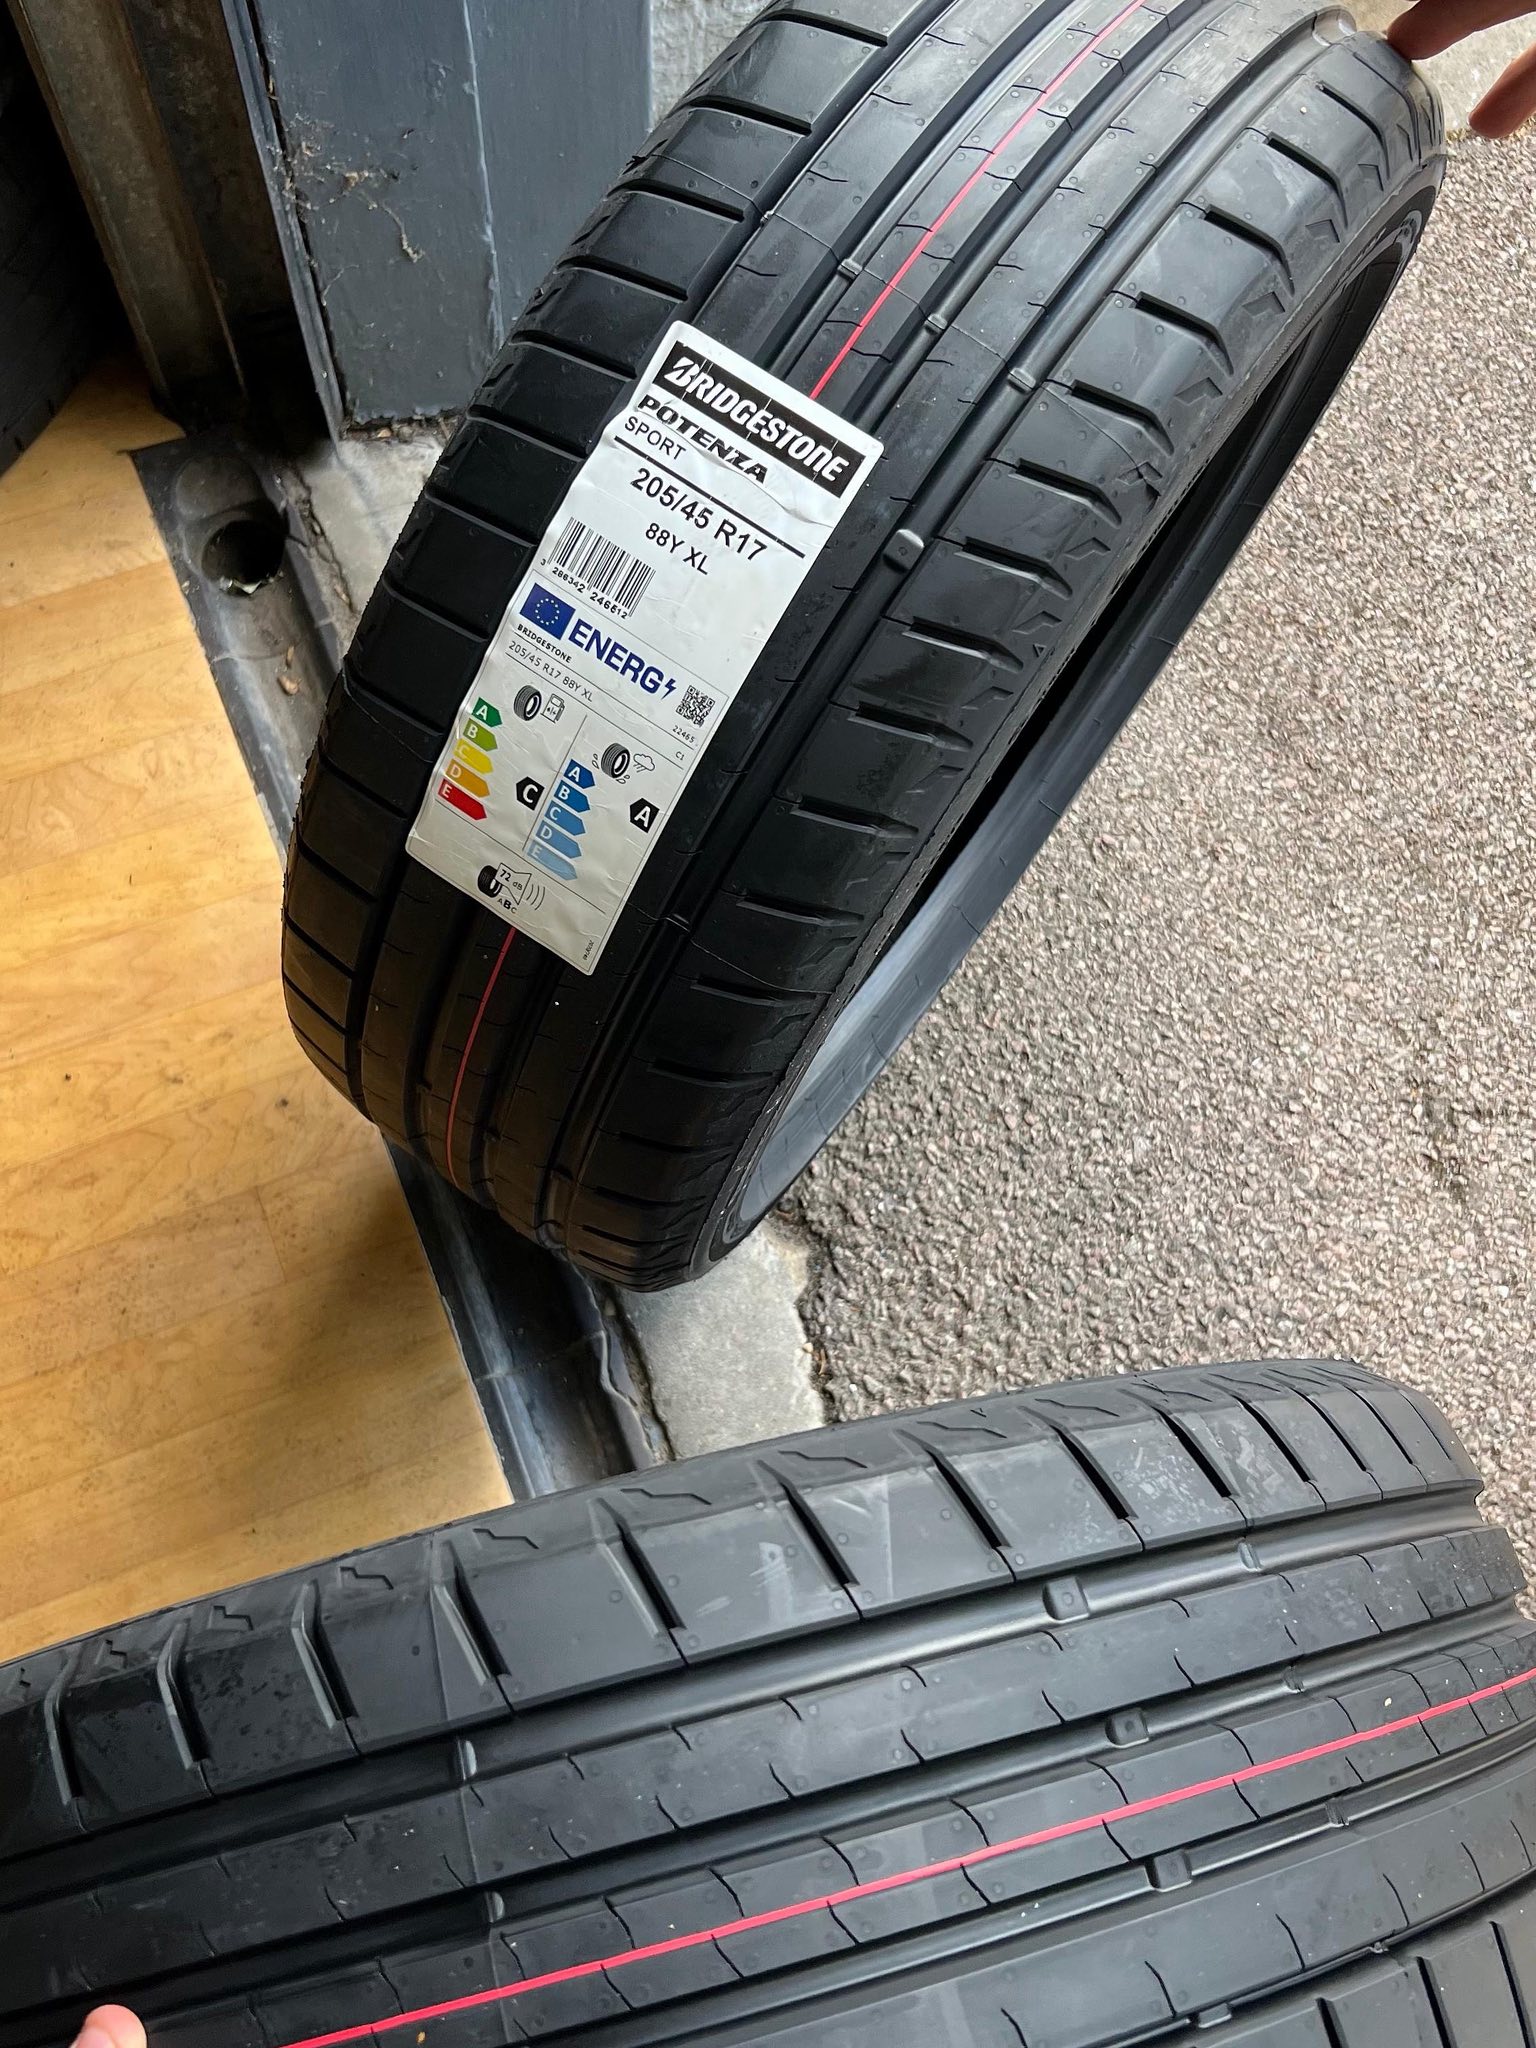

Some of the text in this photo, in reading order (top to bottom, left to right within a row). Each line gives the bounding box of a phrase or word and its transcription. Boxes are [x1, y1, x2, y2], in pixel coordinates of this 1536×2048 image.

[664, 356, 849, 481] BRIDGESTONE
[624, 416, 686, 461] SPORT
[637, 394, 768, 484] POTENZA
[630, 467, 768, 561] 205/45 R17
[645, 522, 709, 576] 88Y XL
[540, 558, 547, 567] 3
[551, 566, 586, 594] 286342
[517, 623, 572, 664] BRIDGESTONE
[568, 618, 664, 694] ENERG
[508, 640, 593, 702] 205/45 R17 88Y XL
[475, 705, 488, 721] A
[467, 724, 478, 739] B
[672, 725, 696, 744] 22465
[450, 764, 462, 779] D
[568, 766, 581, 783] A
[443, 784, 453, 799] E
[522, 783, 539, 804] C
[558, 785, 571, 801] B
[549, 806, 562, 821] C
[633, 805, 651, 828] A
[541, 825, 553, 840] D
[531, 845, 543, 859] E
[499, 868, 512, 882] 72
